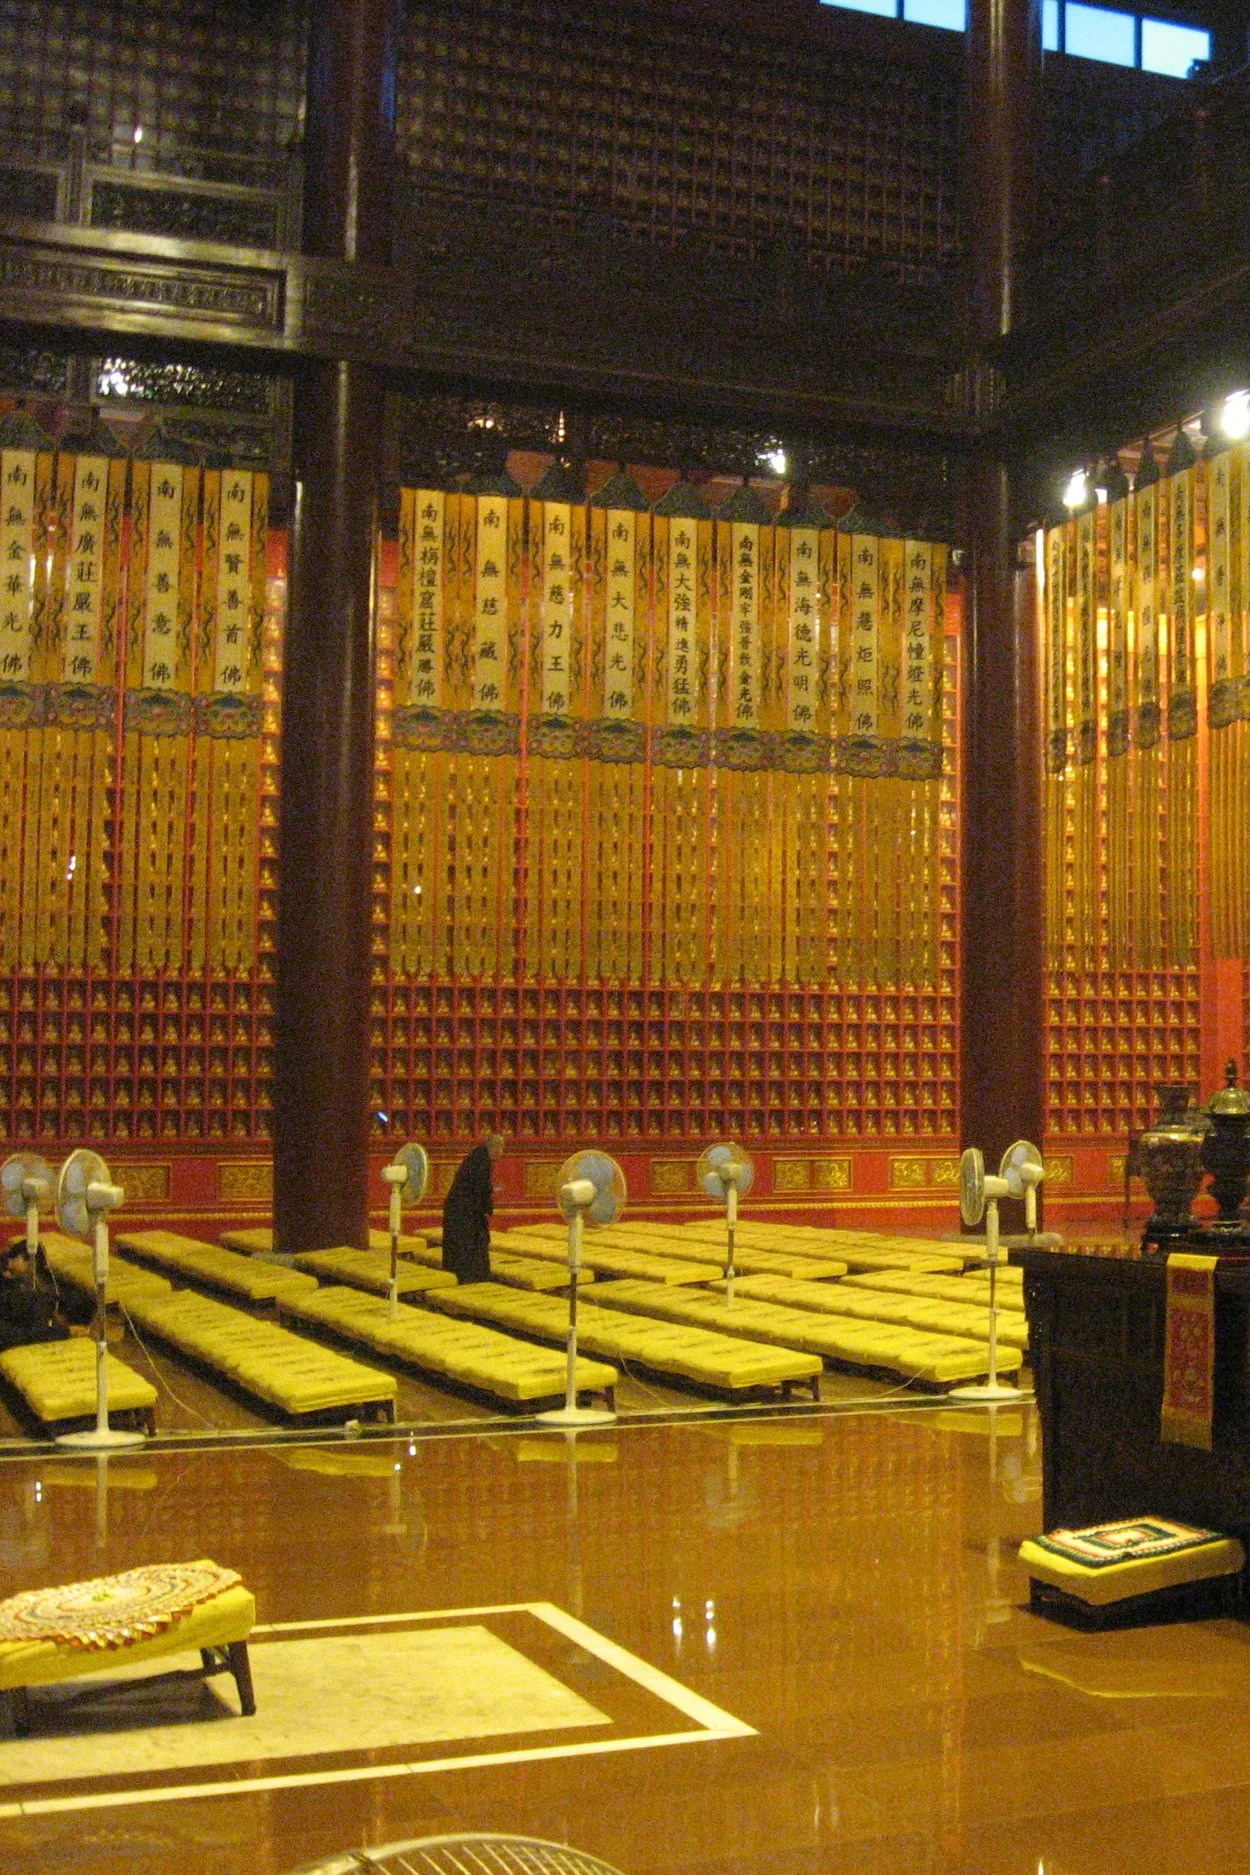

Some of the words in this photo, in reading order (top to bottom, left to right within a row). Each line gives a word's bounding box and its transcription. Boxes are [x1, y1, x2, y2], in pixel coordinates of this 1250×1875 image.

[605, 522, 630, 711] 南無大悲光佛
[792, 540, 813, 724] 南無海德光明佛
